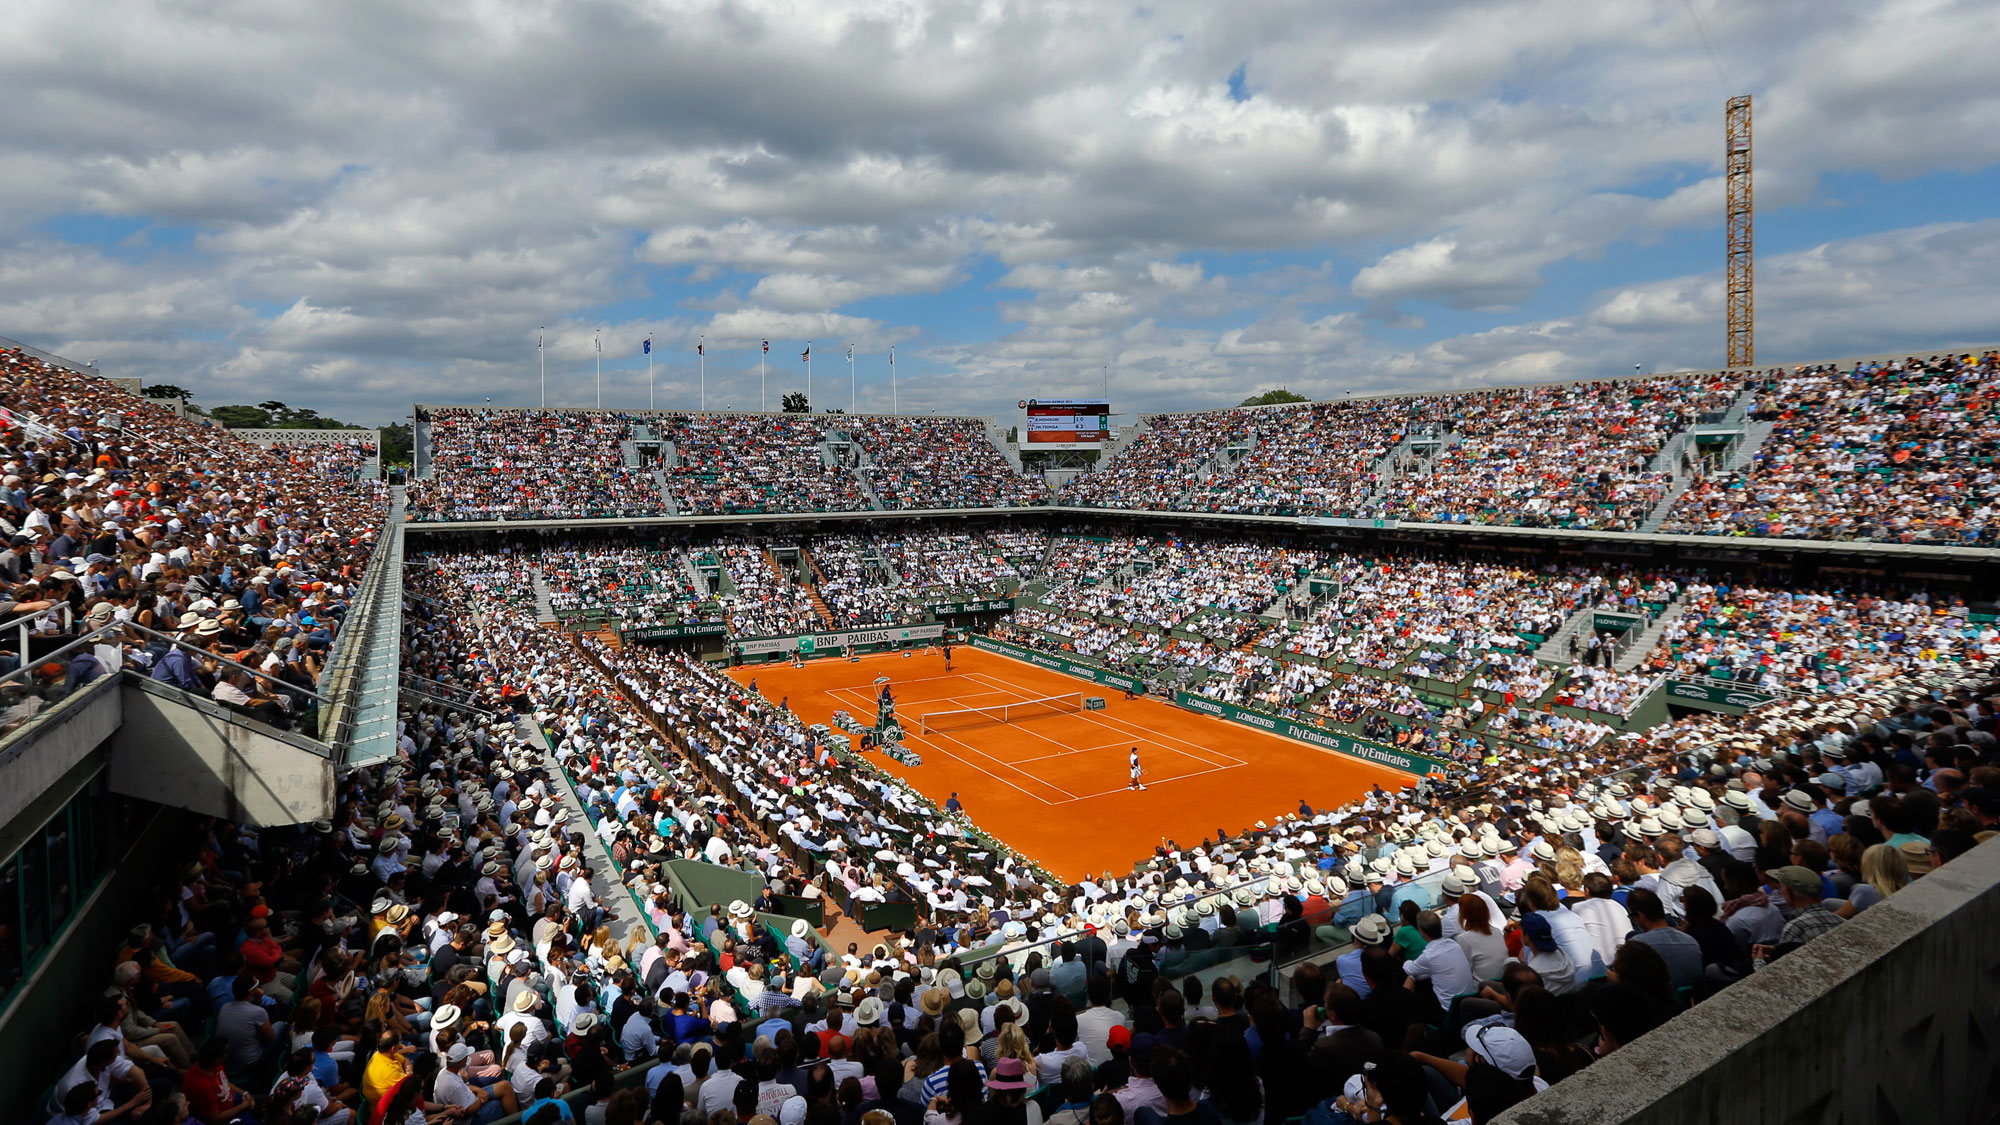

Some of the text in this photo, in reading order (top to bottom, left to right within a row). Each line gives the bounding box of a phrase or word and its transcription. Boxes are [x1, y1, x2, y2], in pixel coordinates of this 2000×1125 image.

[935, 606, 957, 615] FedEx
[963, 603, 984, 612] FedEx
[989, 601, 1009, 610] FedEx
[648, 628, 679, 637] Emirates
[696, 624, 727, 633] Emirates
[816, 631, 889, 647] BNP PARIBAS
[976, 640, 999, 650] PEUGEOT
[1003, 647, 1026, 658] PEUGEOT
[1036, 657, 1062, 668] PEUGEOT
[1069, 665, 1095, 678] LONGINES
[1105, 675, 1133, 688] LONGINES
[1187, 698, 1222, 714] LONGINES
[1236, 711, 1275, 728] LONGINES
[1303, 730, 1340, 748] Emirates
[1368, 747, 1411, 768] Emirates
